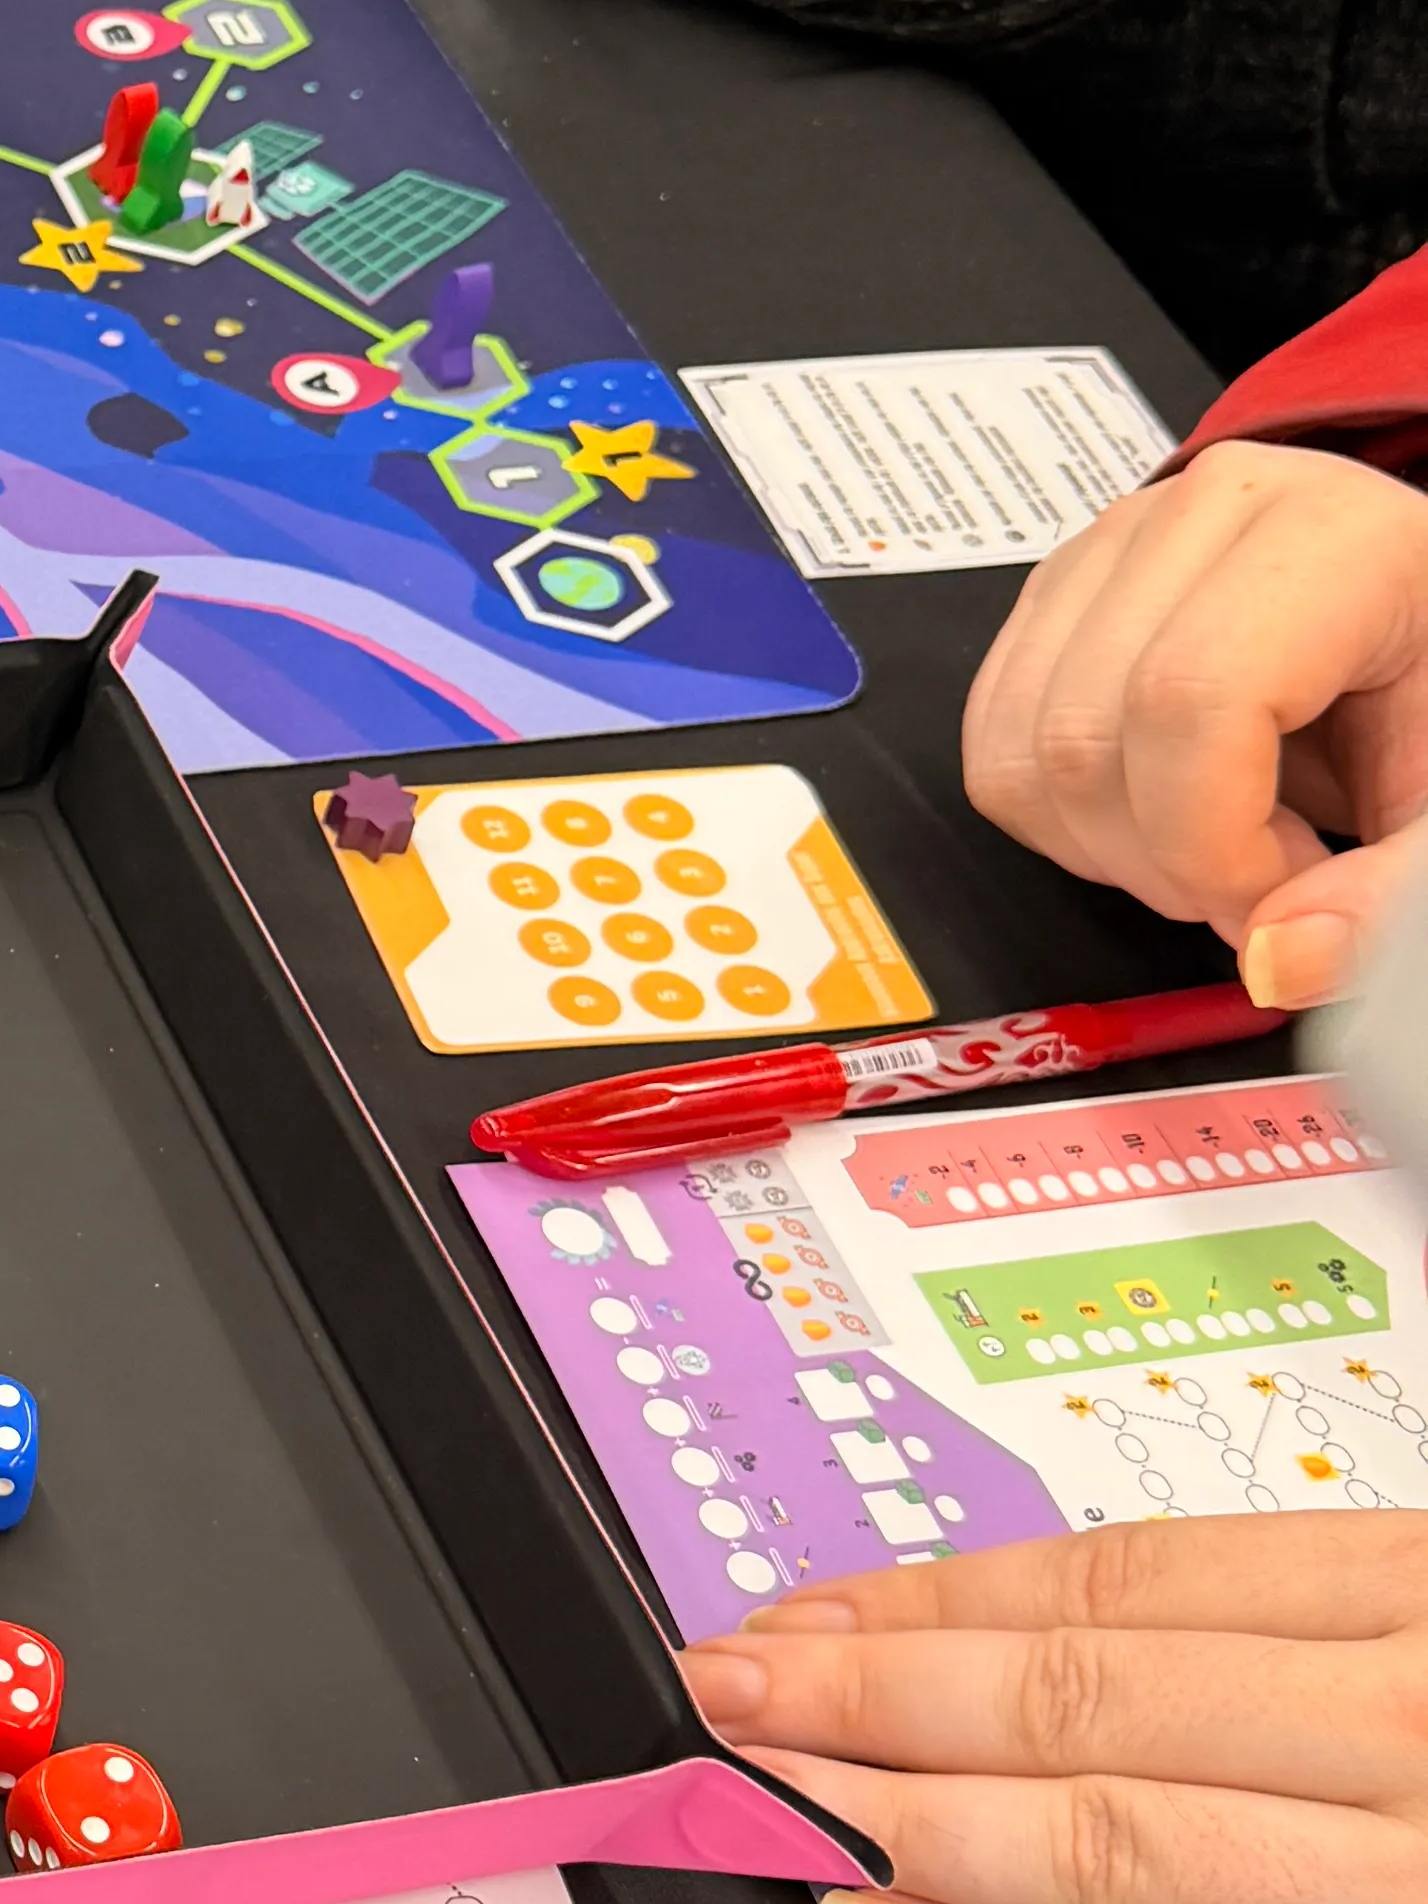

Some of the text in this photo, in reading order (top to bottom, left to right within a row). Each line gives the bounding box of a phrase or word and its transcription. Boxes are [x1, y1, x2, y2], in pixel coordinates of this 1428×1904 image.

[209, 10, 264, 47] 2
[301, 371, 341, 397] A
[606, 449, 643, 470] 1
[488, 465, 540, 491] 1
